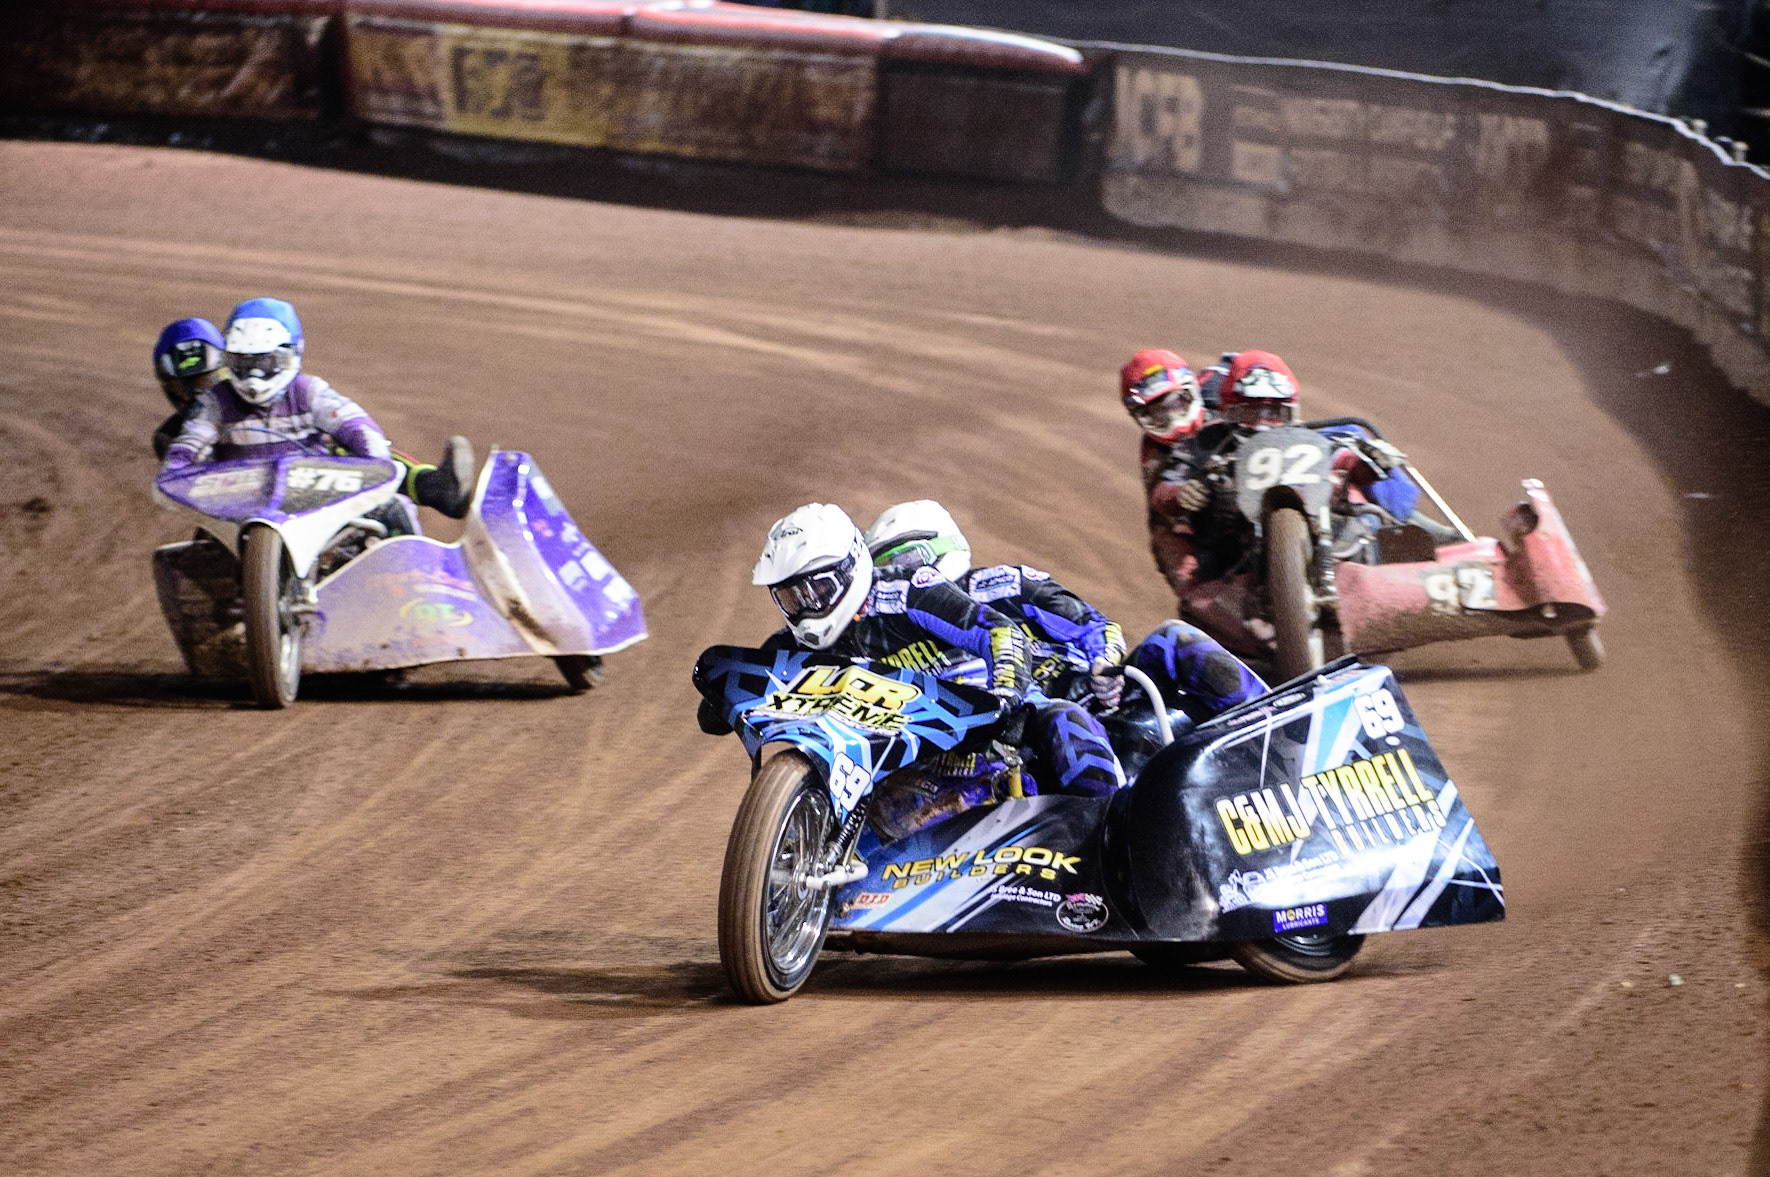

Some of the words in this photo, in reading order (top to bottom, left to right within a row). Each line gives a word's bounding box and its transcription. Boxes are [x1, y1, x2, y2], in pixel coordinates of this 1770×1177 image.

[1245, 444, 1323, 490] 92
[1425, 567, 1496, 609] 92
[1353, 688, 1406, 739] 69
[829, 752, 871, 812] 69
[1301, 748, 1435, 831] TYRRELL
[1330, 800, 1447, 856] BUILDERS
[881, 852, 969, 881] NEW
[973, 846, 1081, 875] LOOK
[892, 863, 1058, 890] BUILDERS
[1044, 891, 1061, 902] LTD
[1275, 903, 1326, 923] MORRIS
